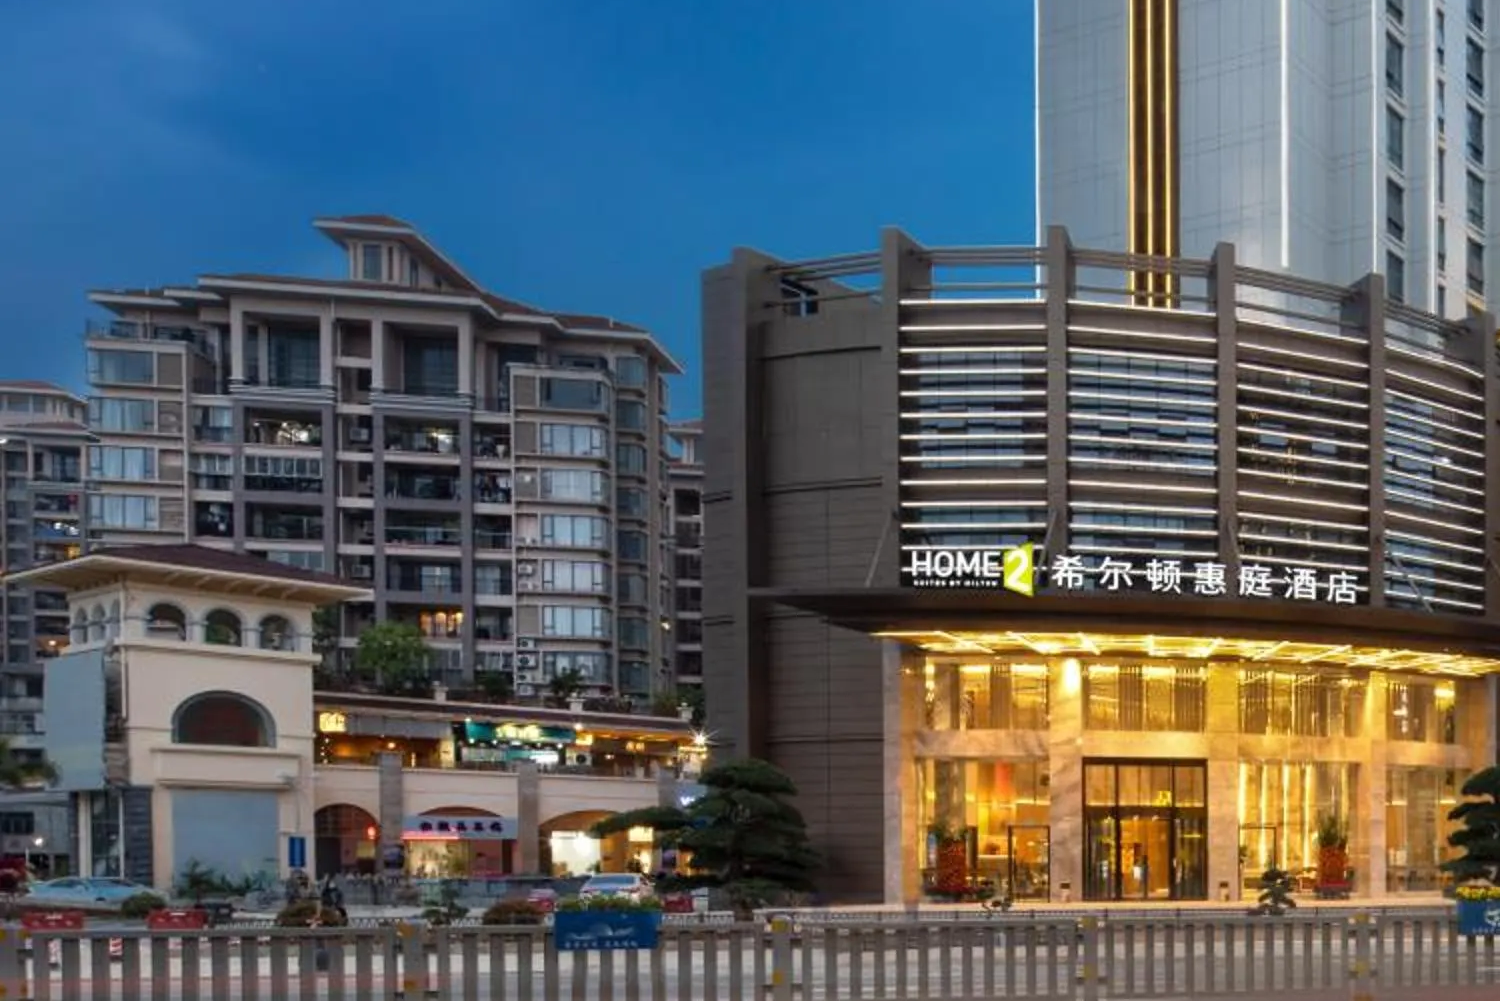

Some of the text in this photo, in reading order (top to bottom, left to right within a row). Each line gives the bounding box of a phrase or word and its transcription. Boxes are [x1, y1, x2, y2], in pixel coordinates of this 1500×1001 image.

[1051, 553, 1359, 604] 希尔顿惠庭酒店
